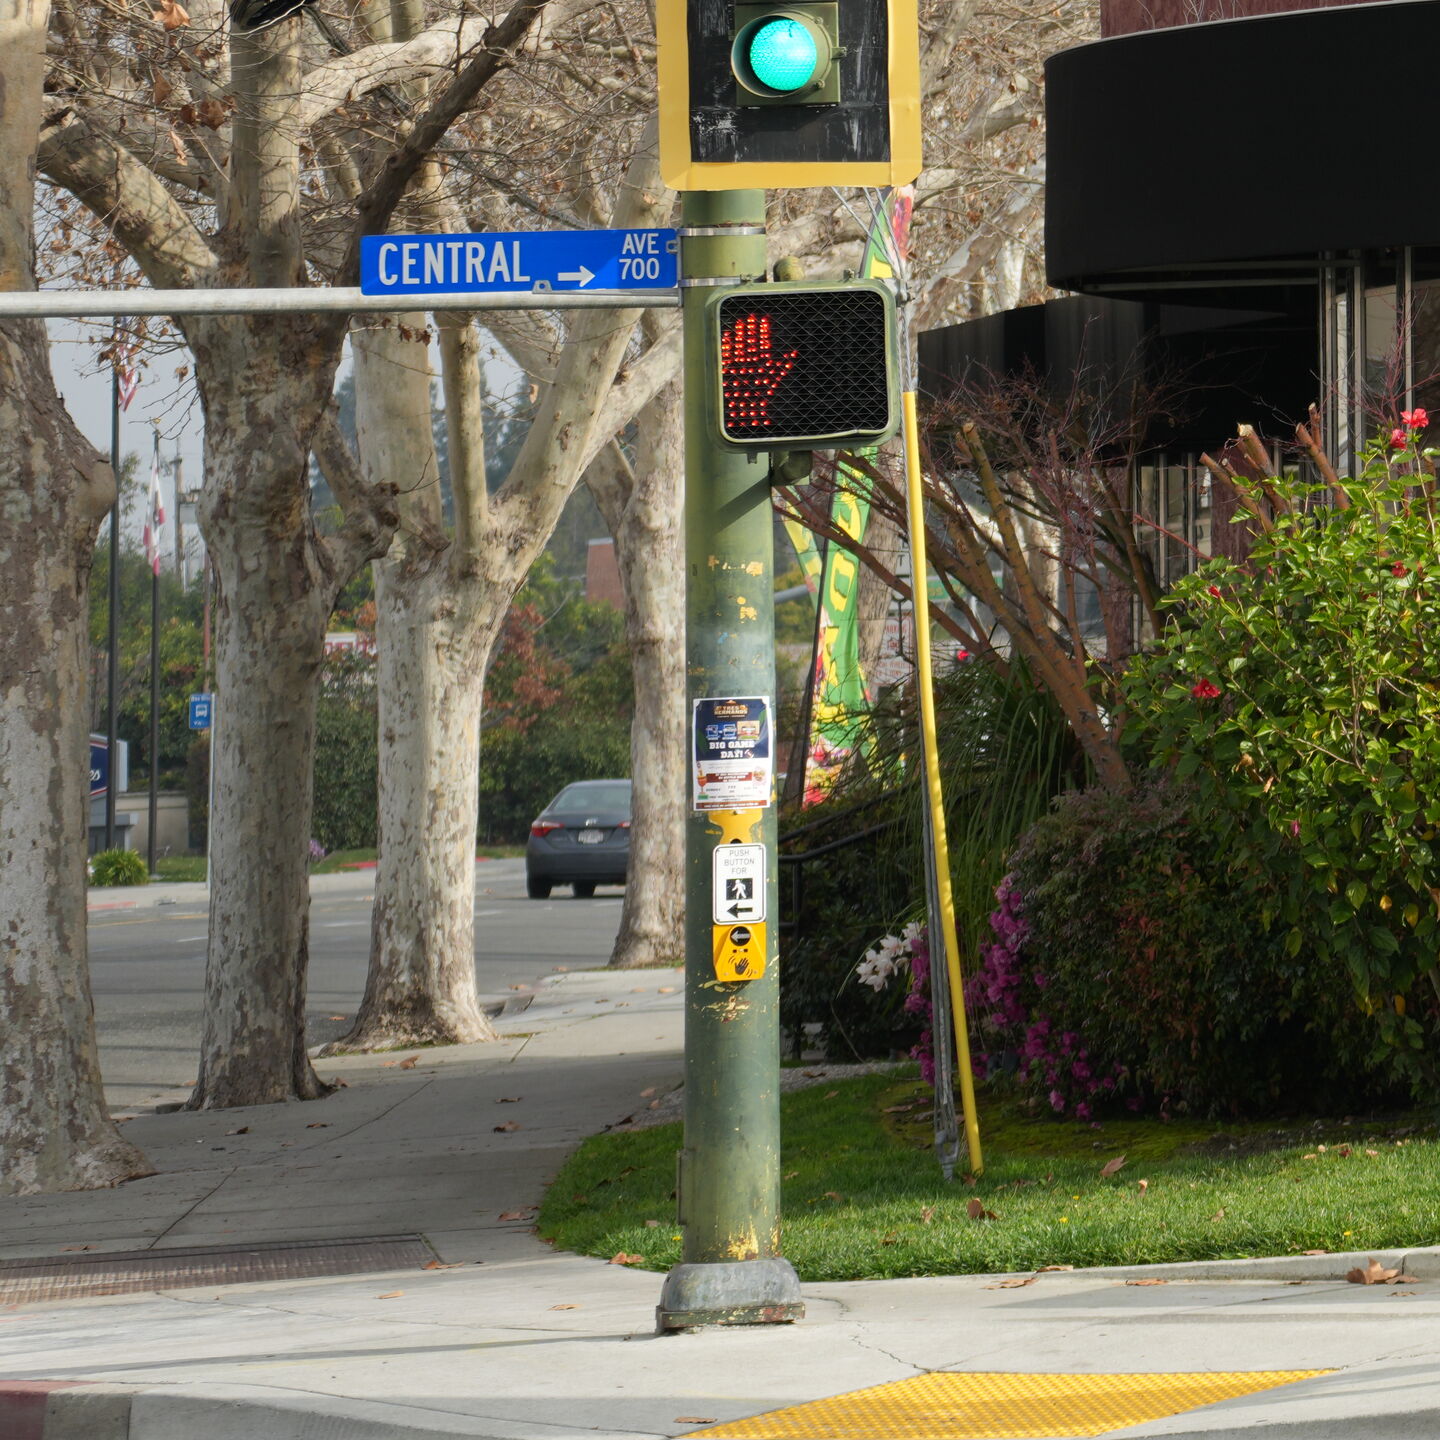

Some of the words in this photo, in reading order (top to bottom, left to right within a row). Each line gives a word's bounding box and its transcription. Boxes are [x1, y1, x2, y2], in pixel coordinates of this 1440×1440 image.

[378, 240, 531, 286] CENTRAL
[621, 233, 660, 255] AVE
[618, 257, 660, 281] 700
[709, 741, 726, 749] BIG
[728, 740, 755, 748] GAME
[720, 750, 744, 758] DAY!
[729, 849, 750, 857] PUSH
[724, 858, 755, 866] BUTTON
[731, 867, 747, 875] FOR
